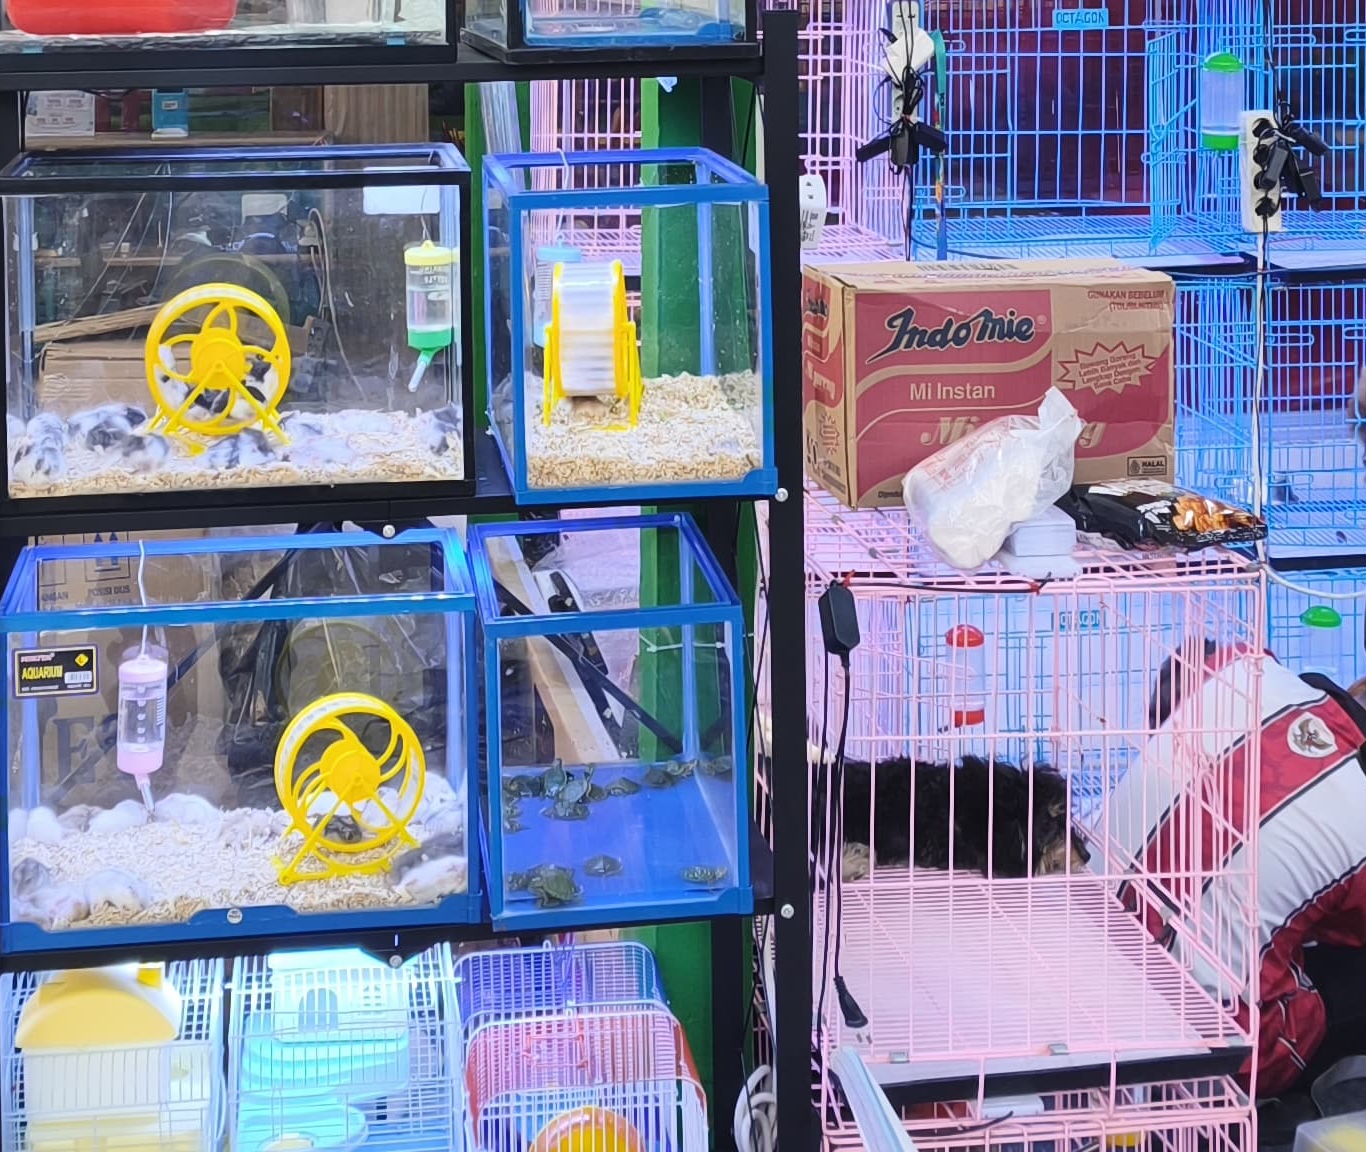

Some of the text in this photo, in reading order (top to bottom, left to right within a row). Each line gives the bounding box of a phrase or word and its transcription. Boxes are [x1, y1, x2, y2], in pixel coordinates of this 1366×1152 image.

[1056, 11, 1105, 24] OCTAGON
[910, 383, 995, 401] Mi Instan
[21, 665, 63, 680] AQUARIUM
